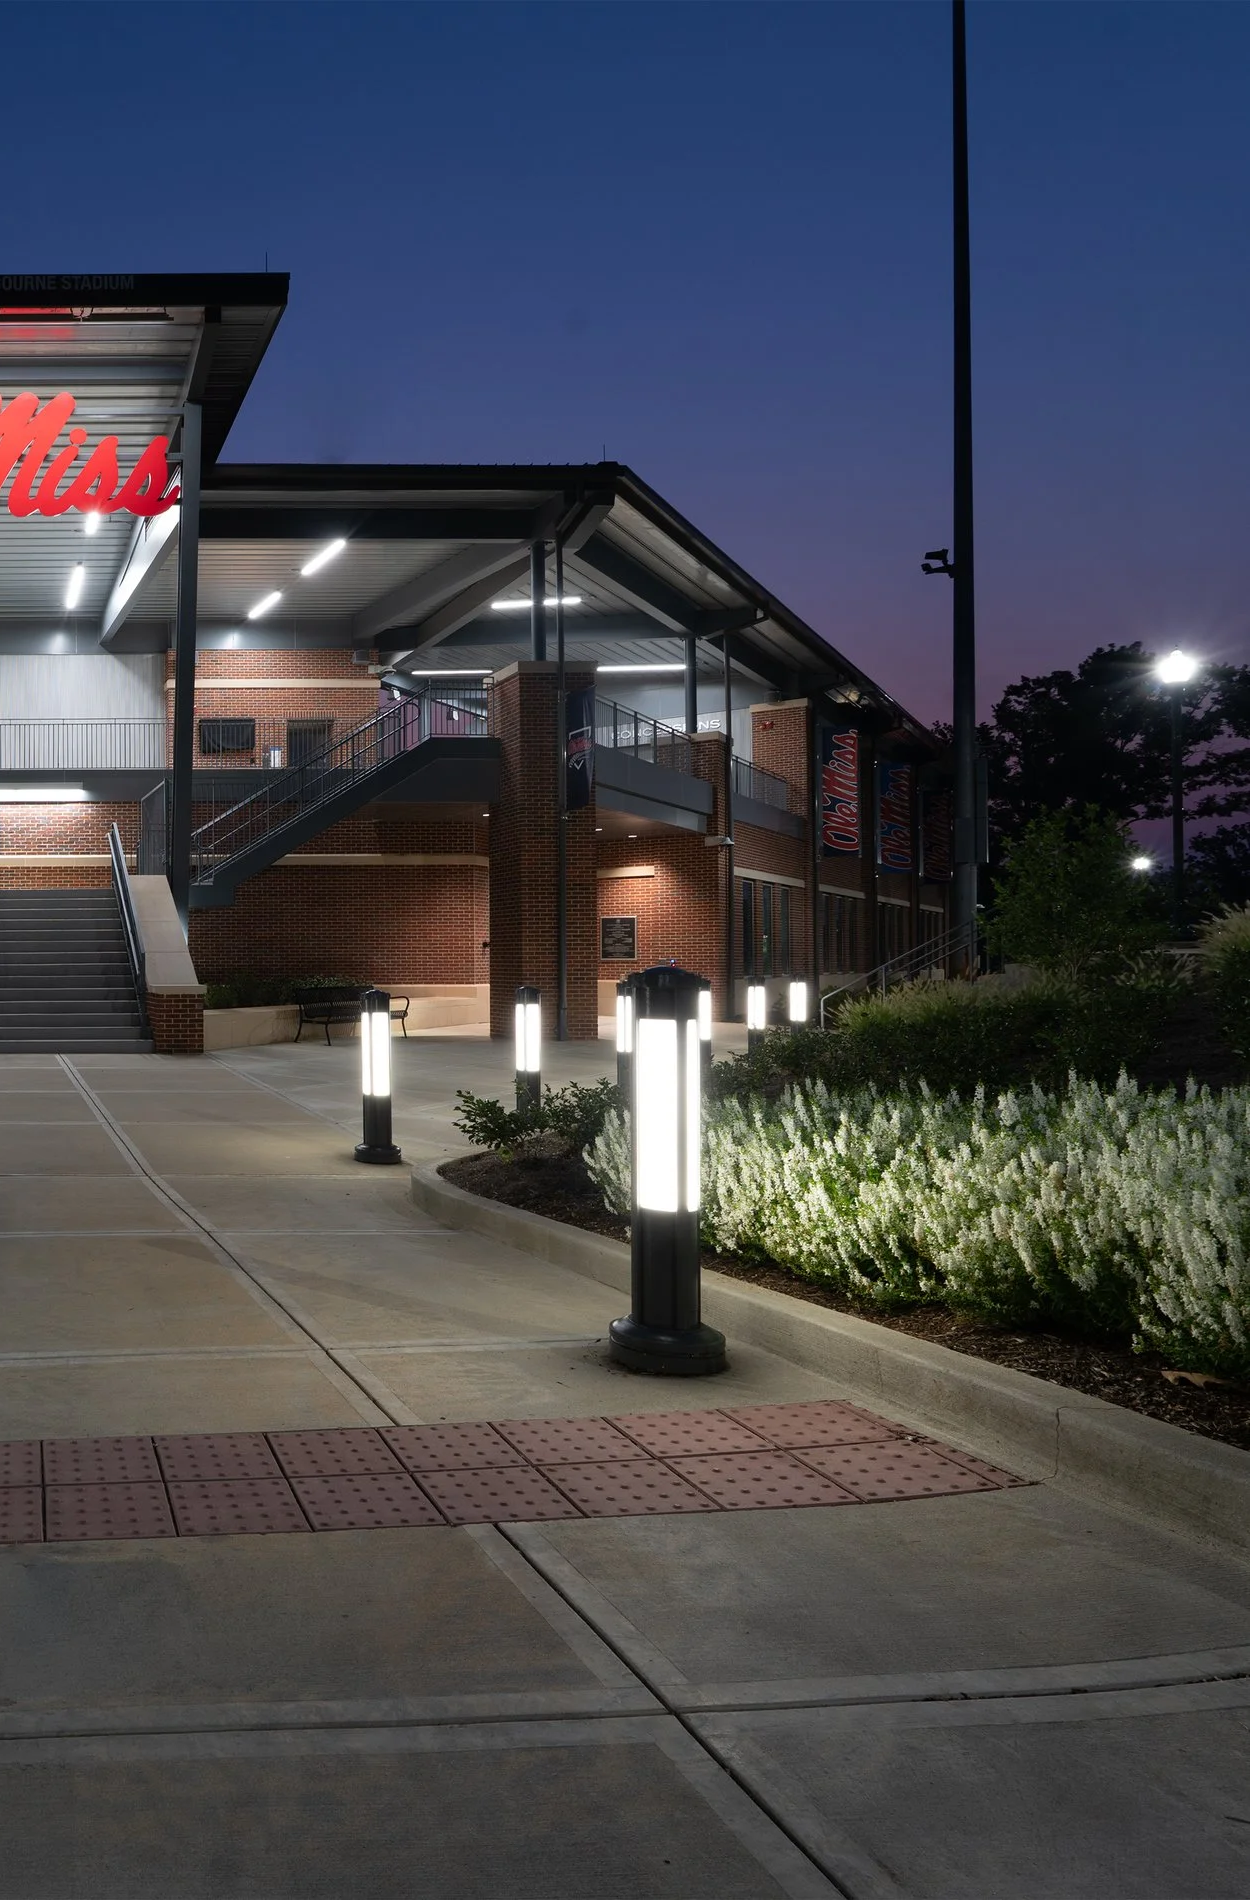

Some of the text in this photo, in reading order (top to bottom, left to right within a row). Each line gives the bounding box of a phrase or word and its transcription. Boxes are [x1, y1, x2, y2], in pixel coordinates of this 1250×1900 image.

[61, 275, 135, 290] STADIUM
[822, 729, 860, 852] Ole Miss
